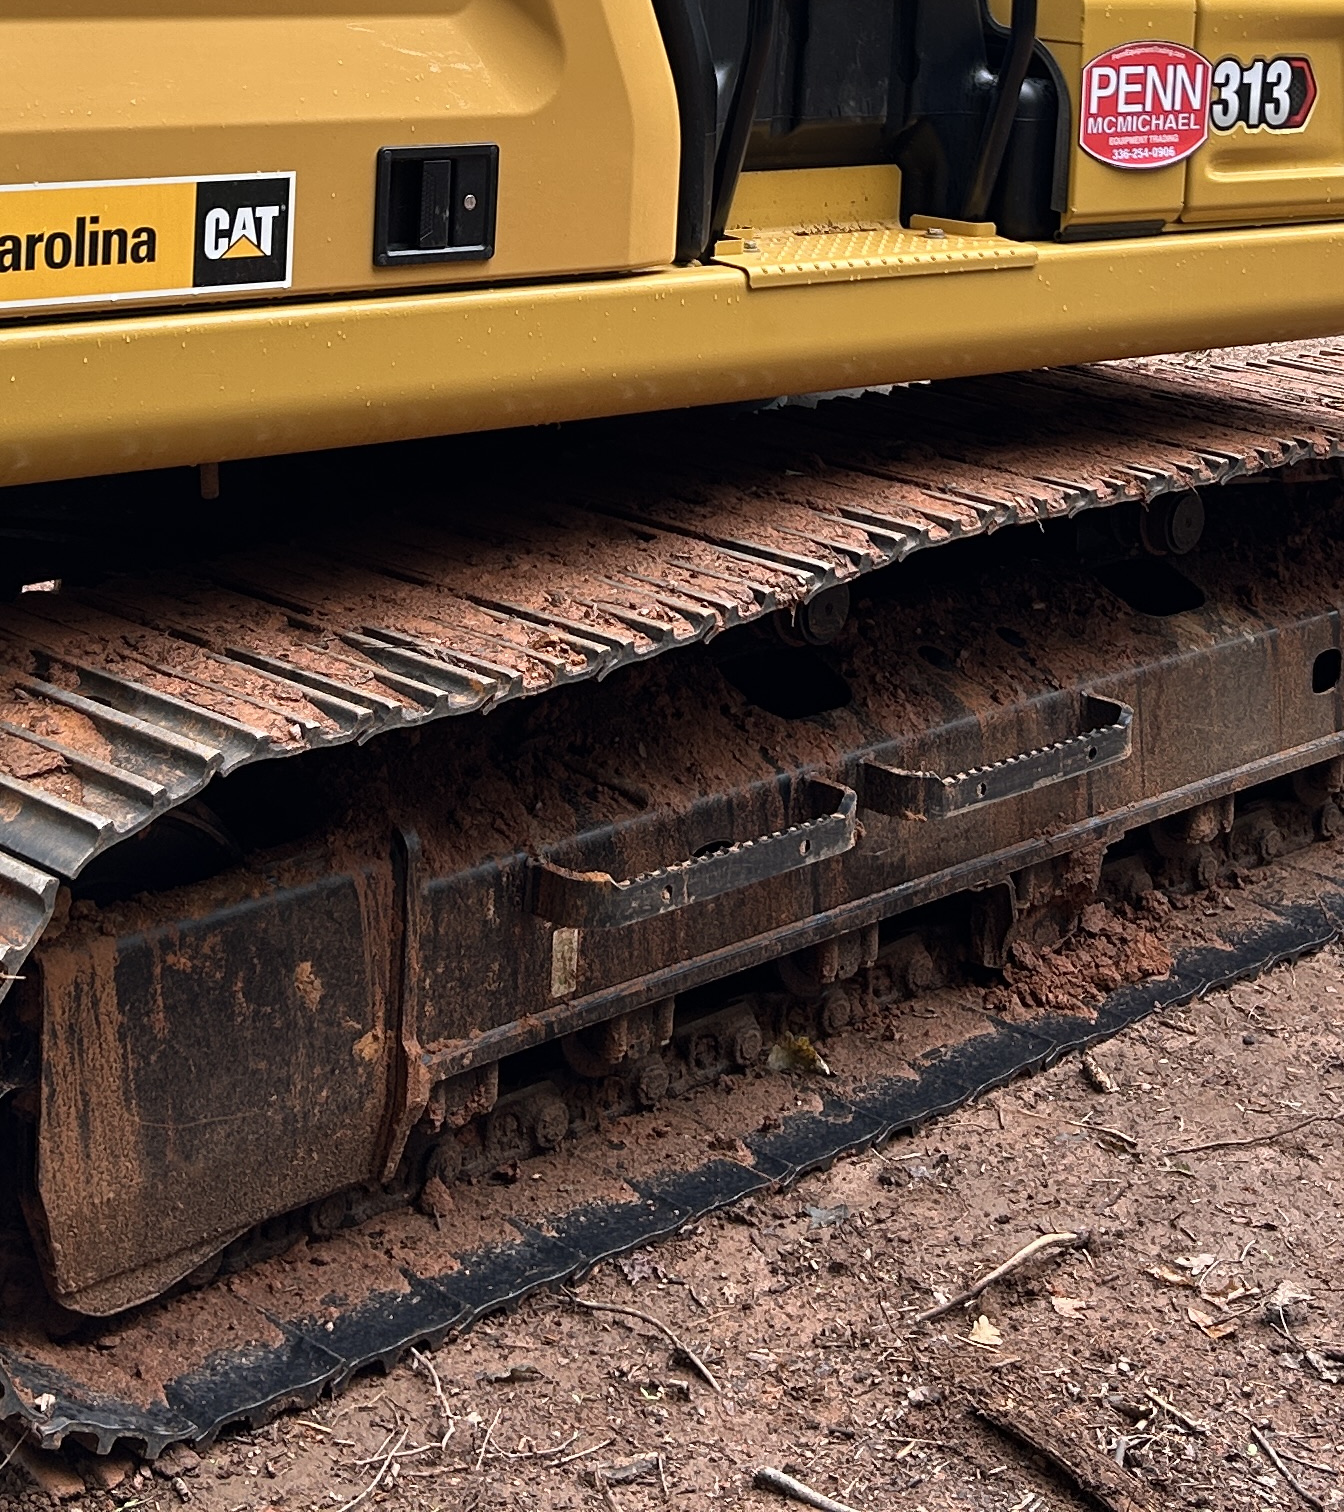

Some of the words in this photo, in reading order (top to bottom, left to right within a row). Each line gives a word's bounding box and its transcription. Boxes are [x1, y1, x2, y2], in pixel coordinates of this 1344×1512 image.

[1088, 63, 1204, 115] PENN
[1212, 59, 1293, 128] 313
[1087, 113, 1201, 134] MCMICHAEL
[203, 204, 280, 261] CAT
